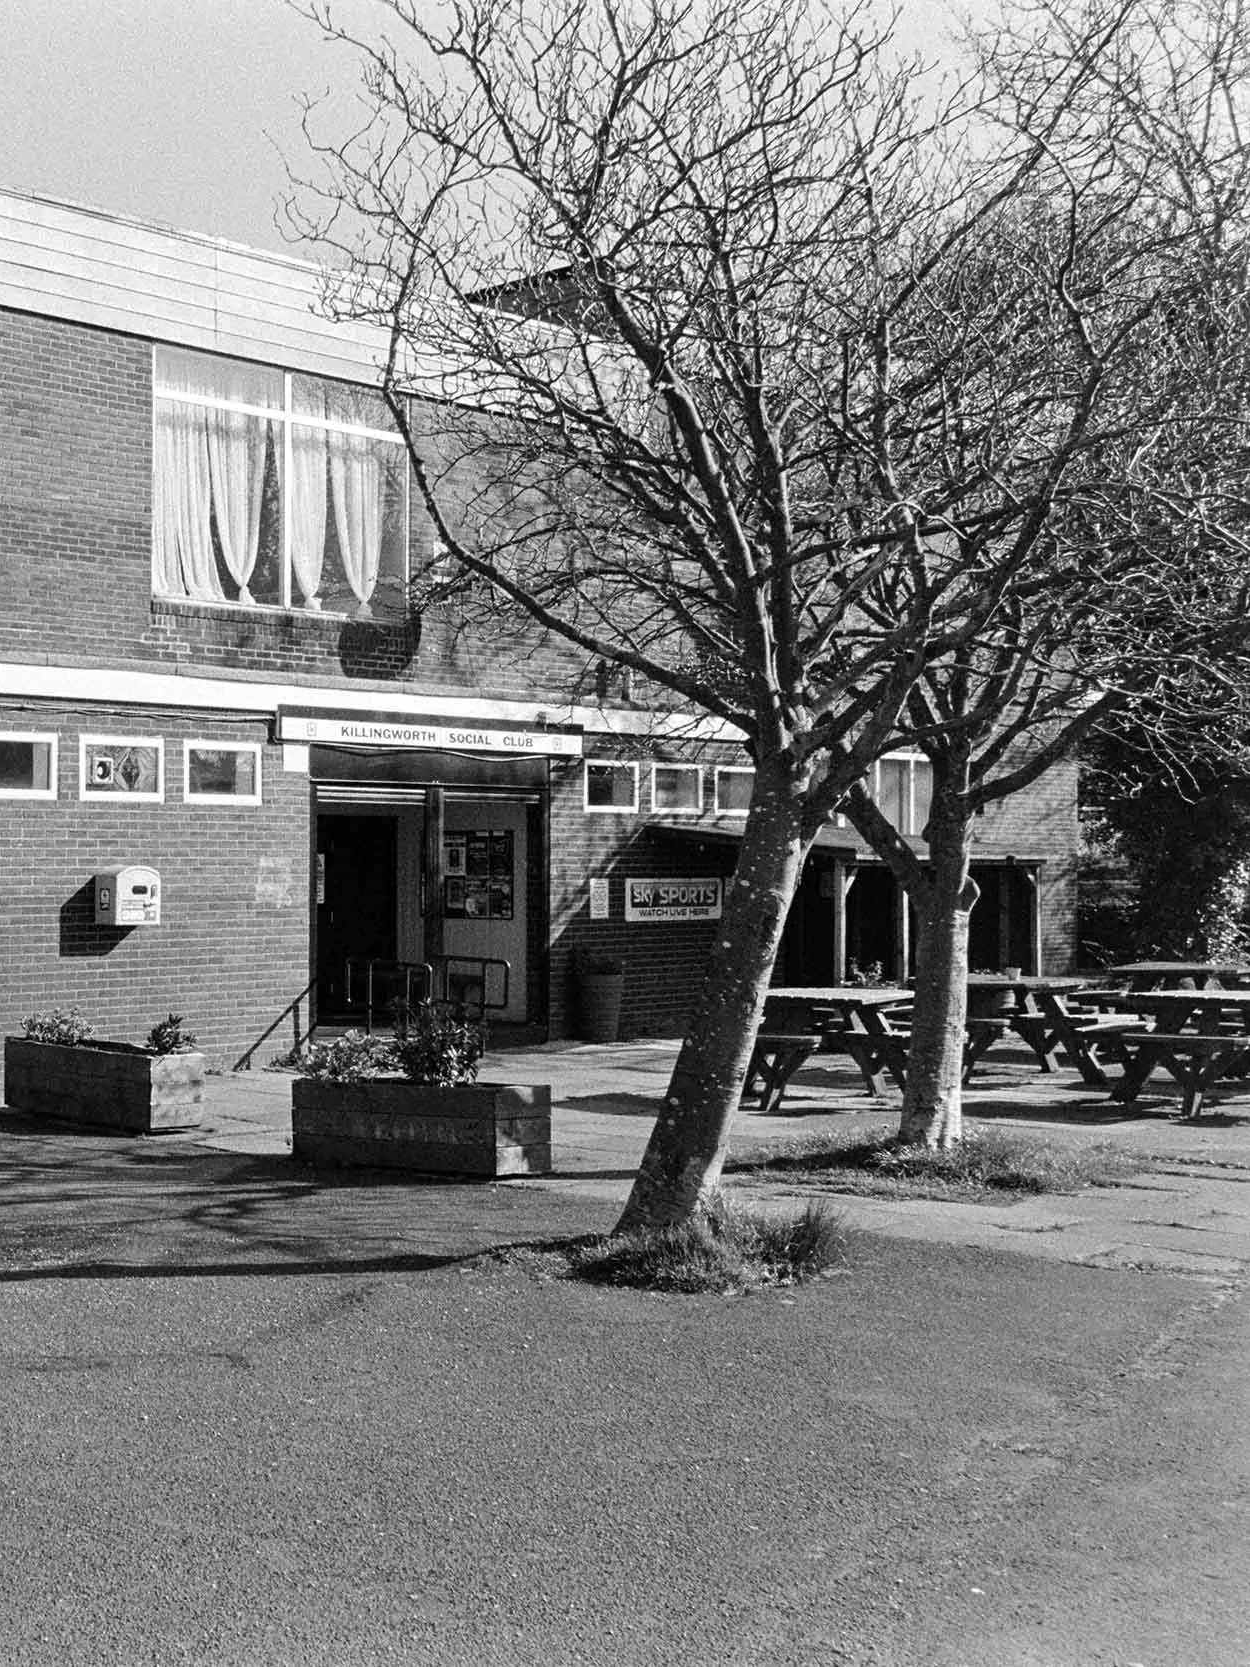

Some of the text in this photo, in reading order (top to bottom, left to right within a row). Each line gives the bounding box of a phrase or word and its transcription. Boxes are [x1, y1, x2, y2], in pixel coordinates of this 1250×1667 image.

[341, 725, 534, 748] KILLINGWORTH SOCIAL CLUB
[660, 886, 715, 904] SPORTS
[638, 909, 668, 917] WATCH
